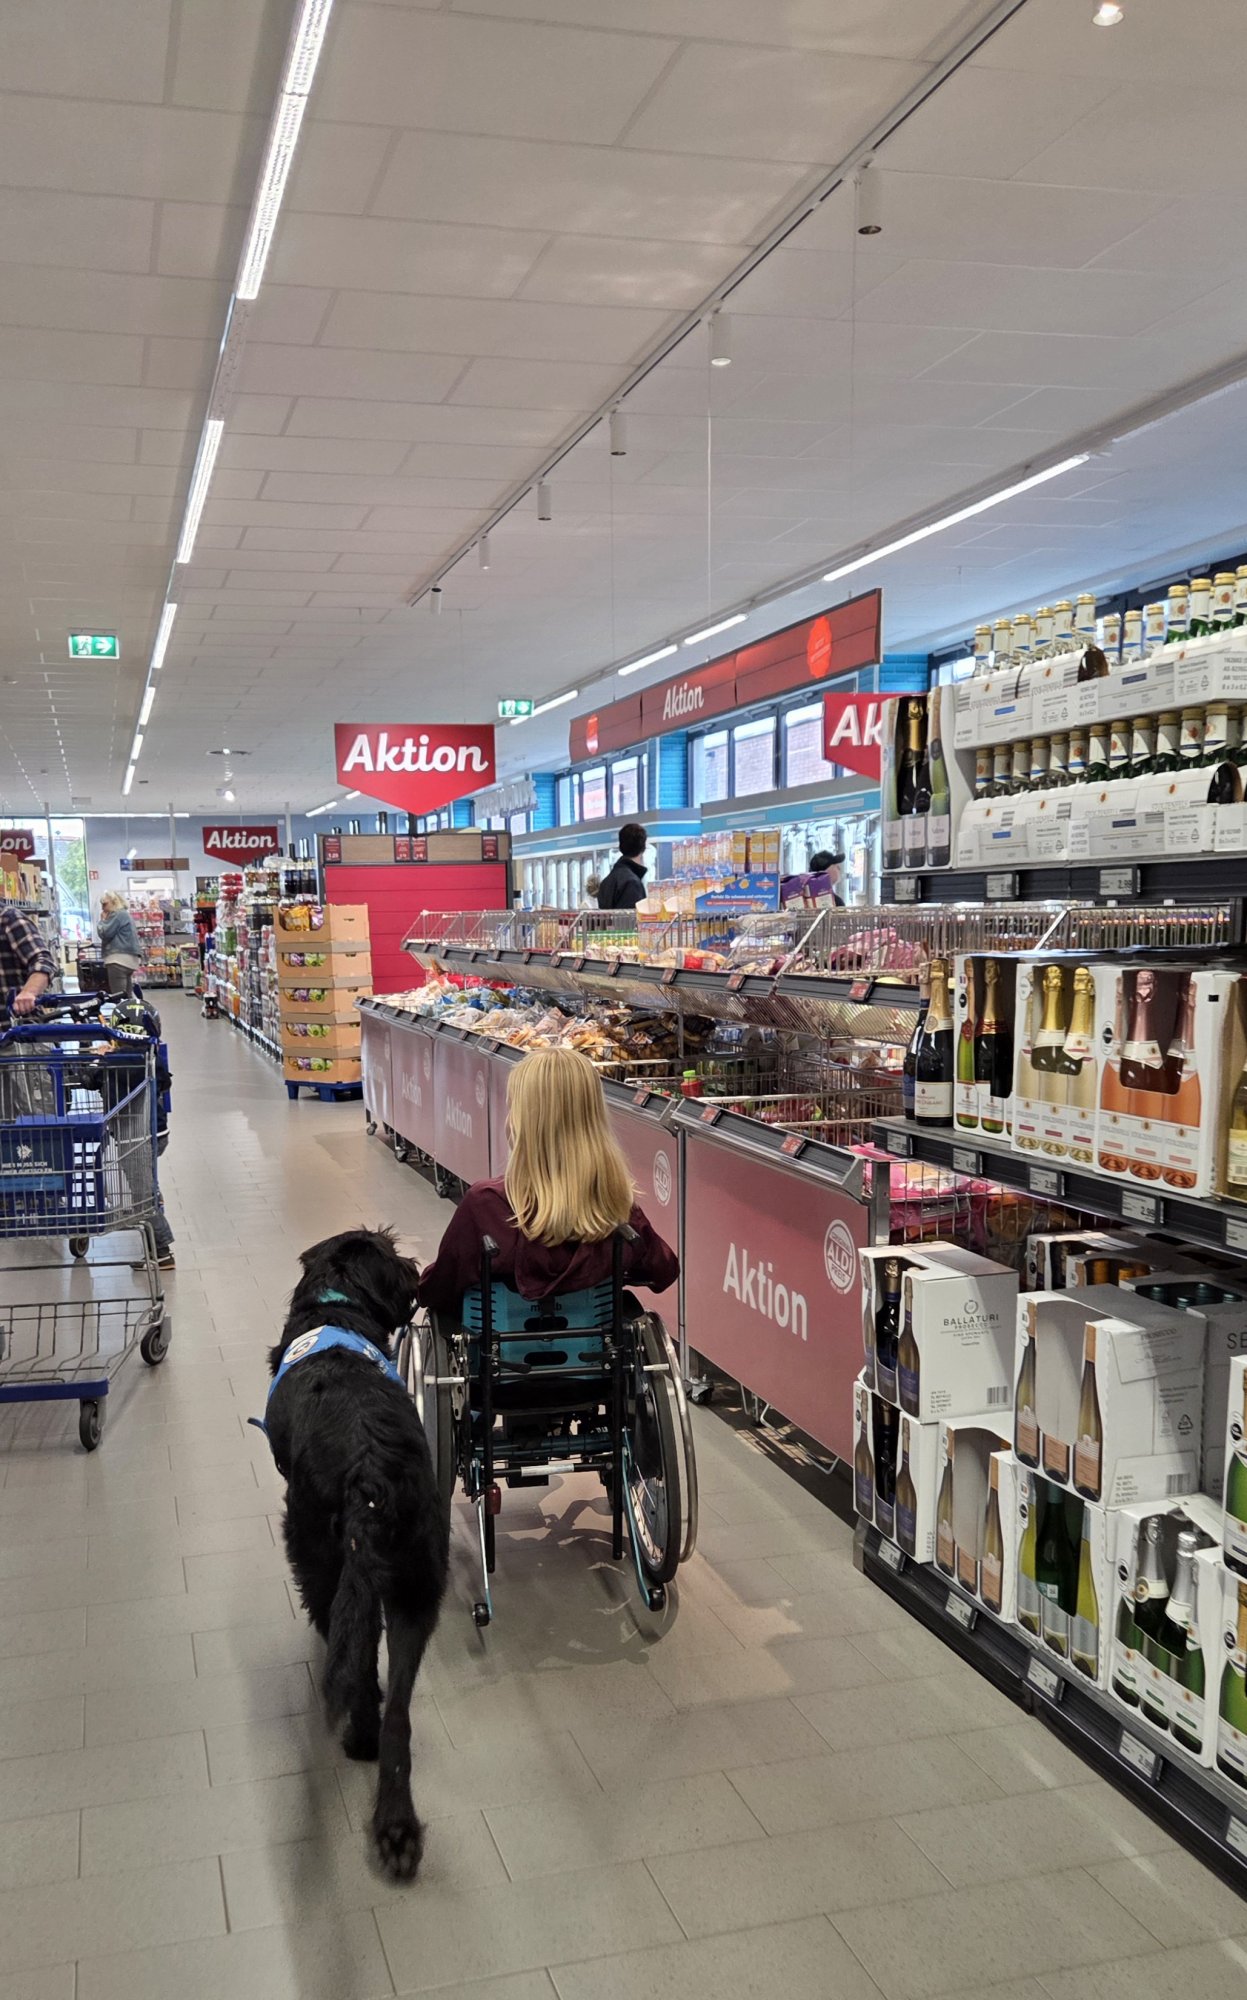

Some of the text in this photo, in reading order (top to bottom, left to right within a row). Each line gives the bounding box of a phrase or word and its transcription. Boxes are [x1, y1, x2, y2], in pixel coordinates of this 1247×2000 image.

[663, 682, 704, 720] Aktion
[342, 732, 489, 772] Aktion
[206, 831, 275, 849] Aktion
[445, 1095, 472, 1138] Aktion
[827, 1240, 853, 1277] ALDI
[723, 1242, 808, 1341] Aktion
[943, 1314, 999, 1326] BALLATURI
